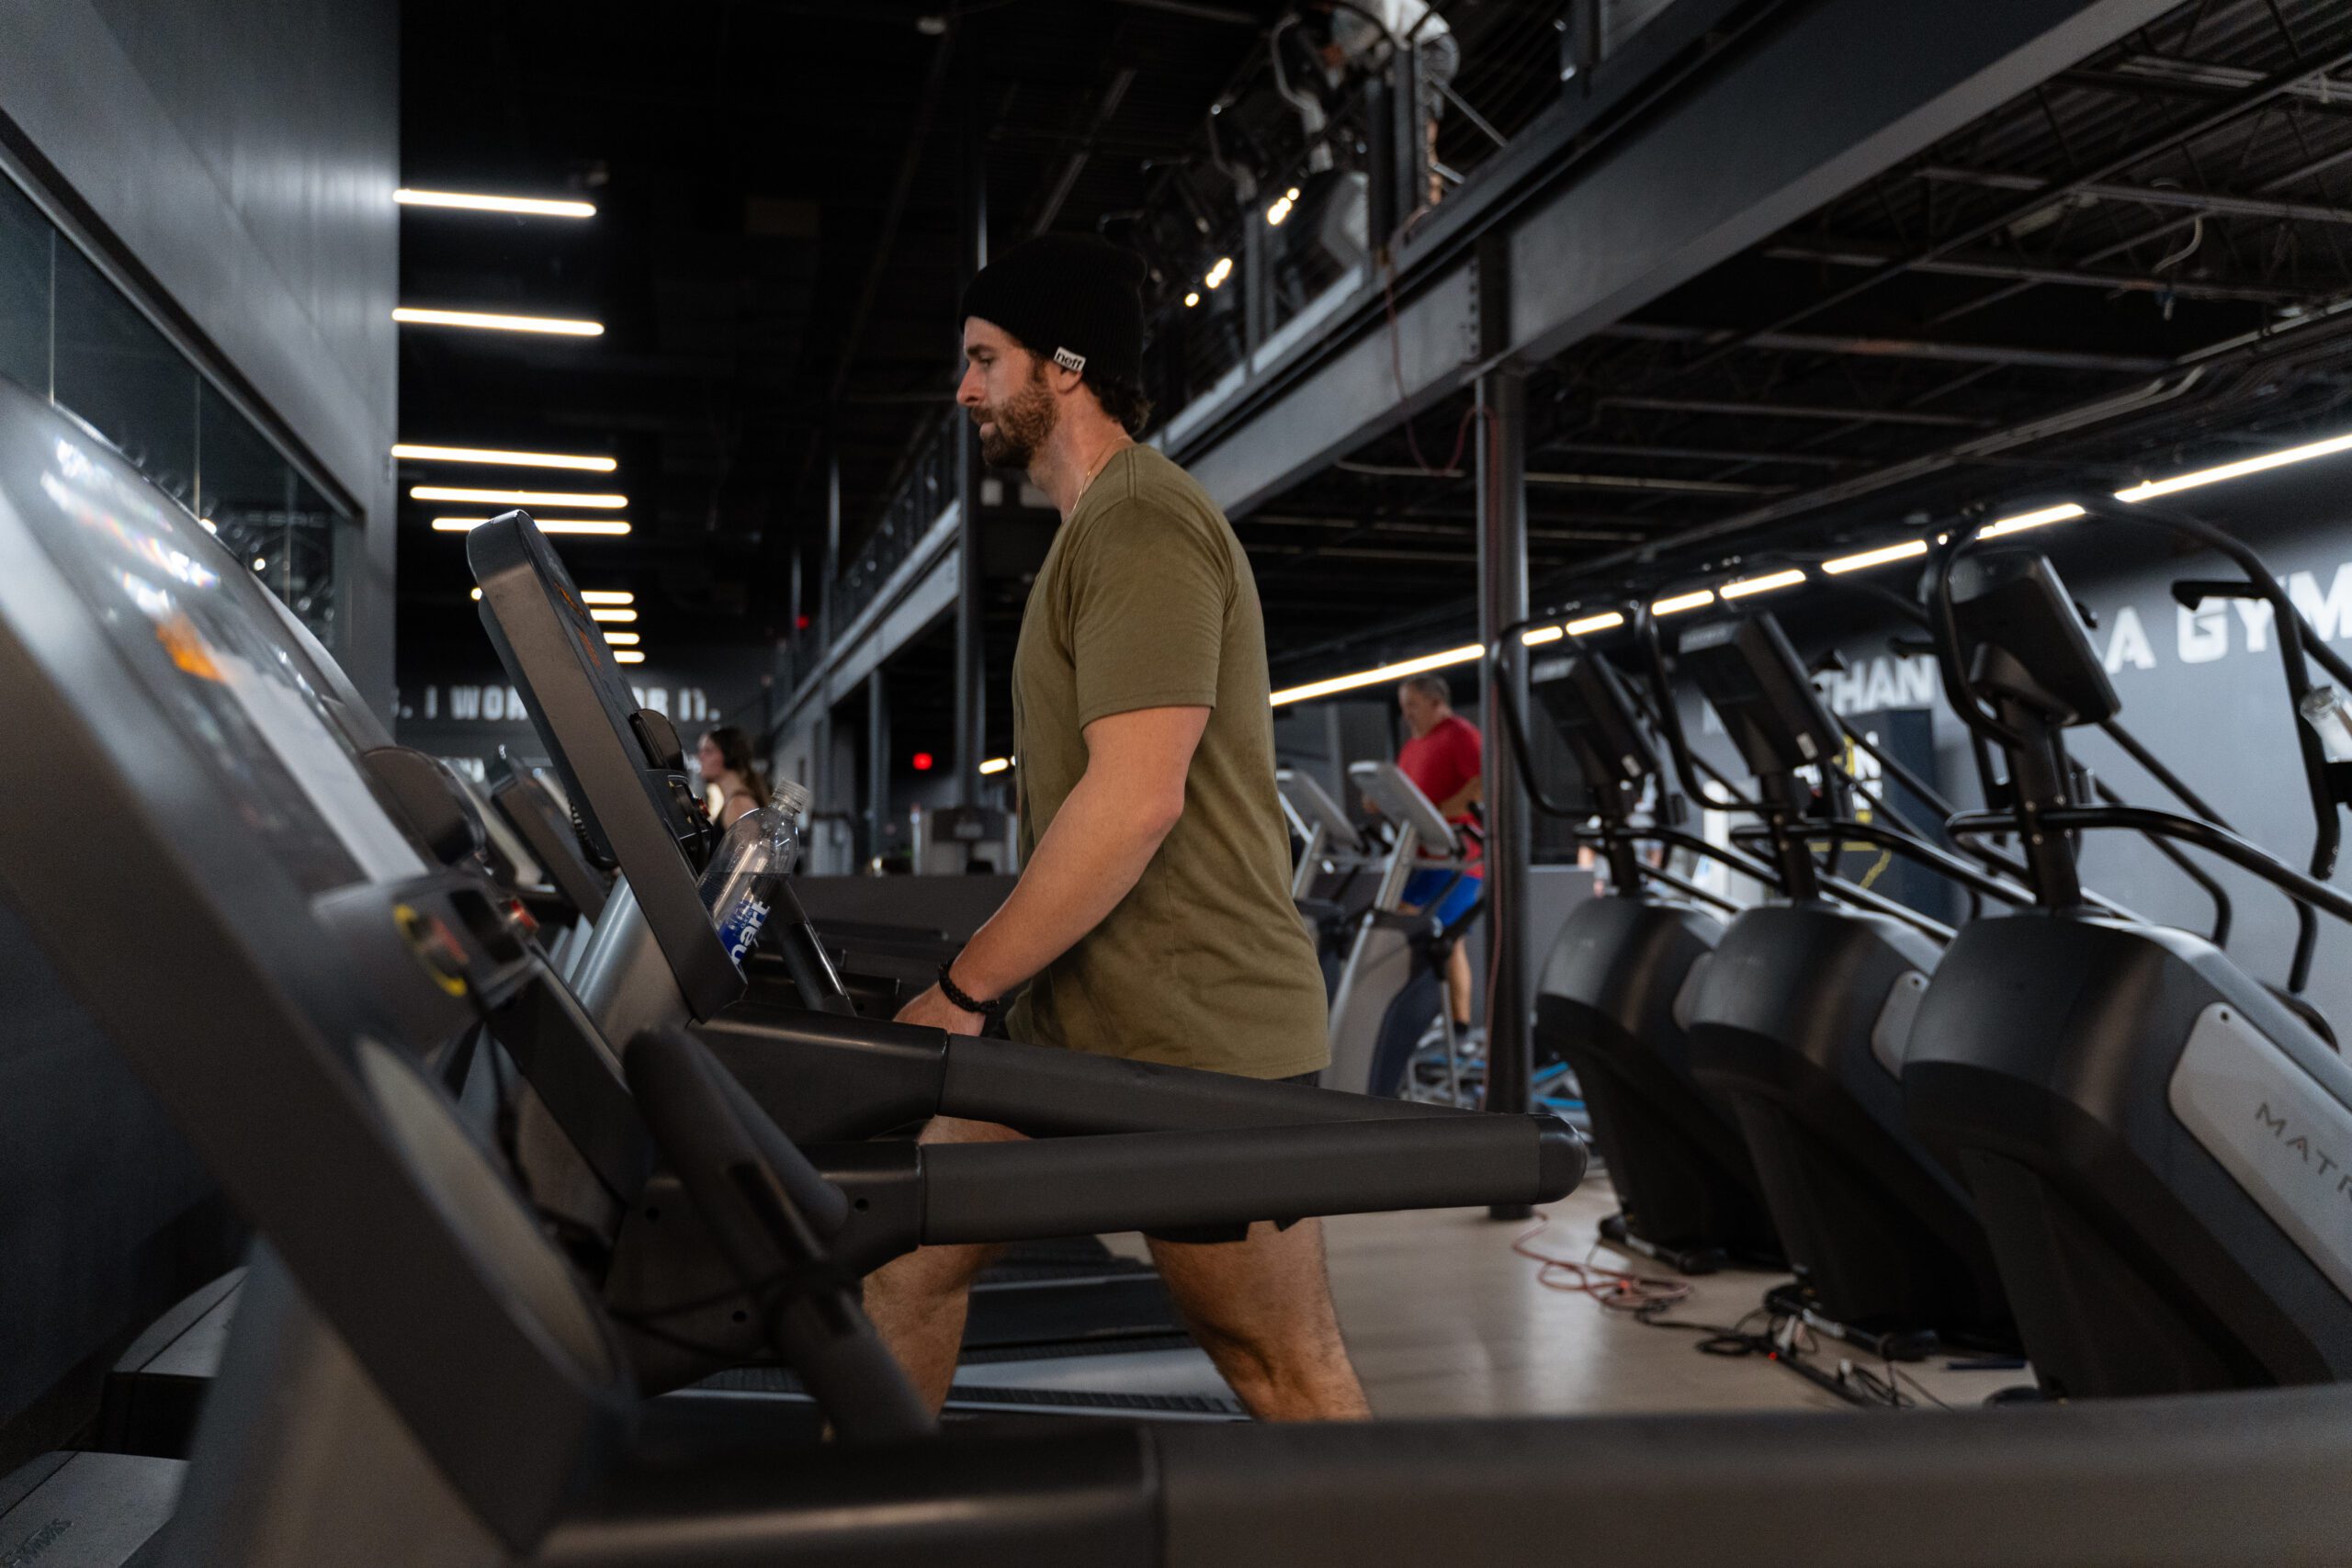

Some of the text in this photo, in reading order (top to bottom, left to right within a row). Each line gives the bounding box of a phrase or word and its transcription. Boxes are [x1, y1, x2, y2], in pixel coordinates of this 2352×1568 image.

[1057, 353, 1082, 368] neff
[2104, 604, 2157, 674] A
[2177, 561, 2352, 664] GYM
[449, 685, 530, 721] WOR
